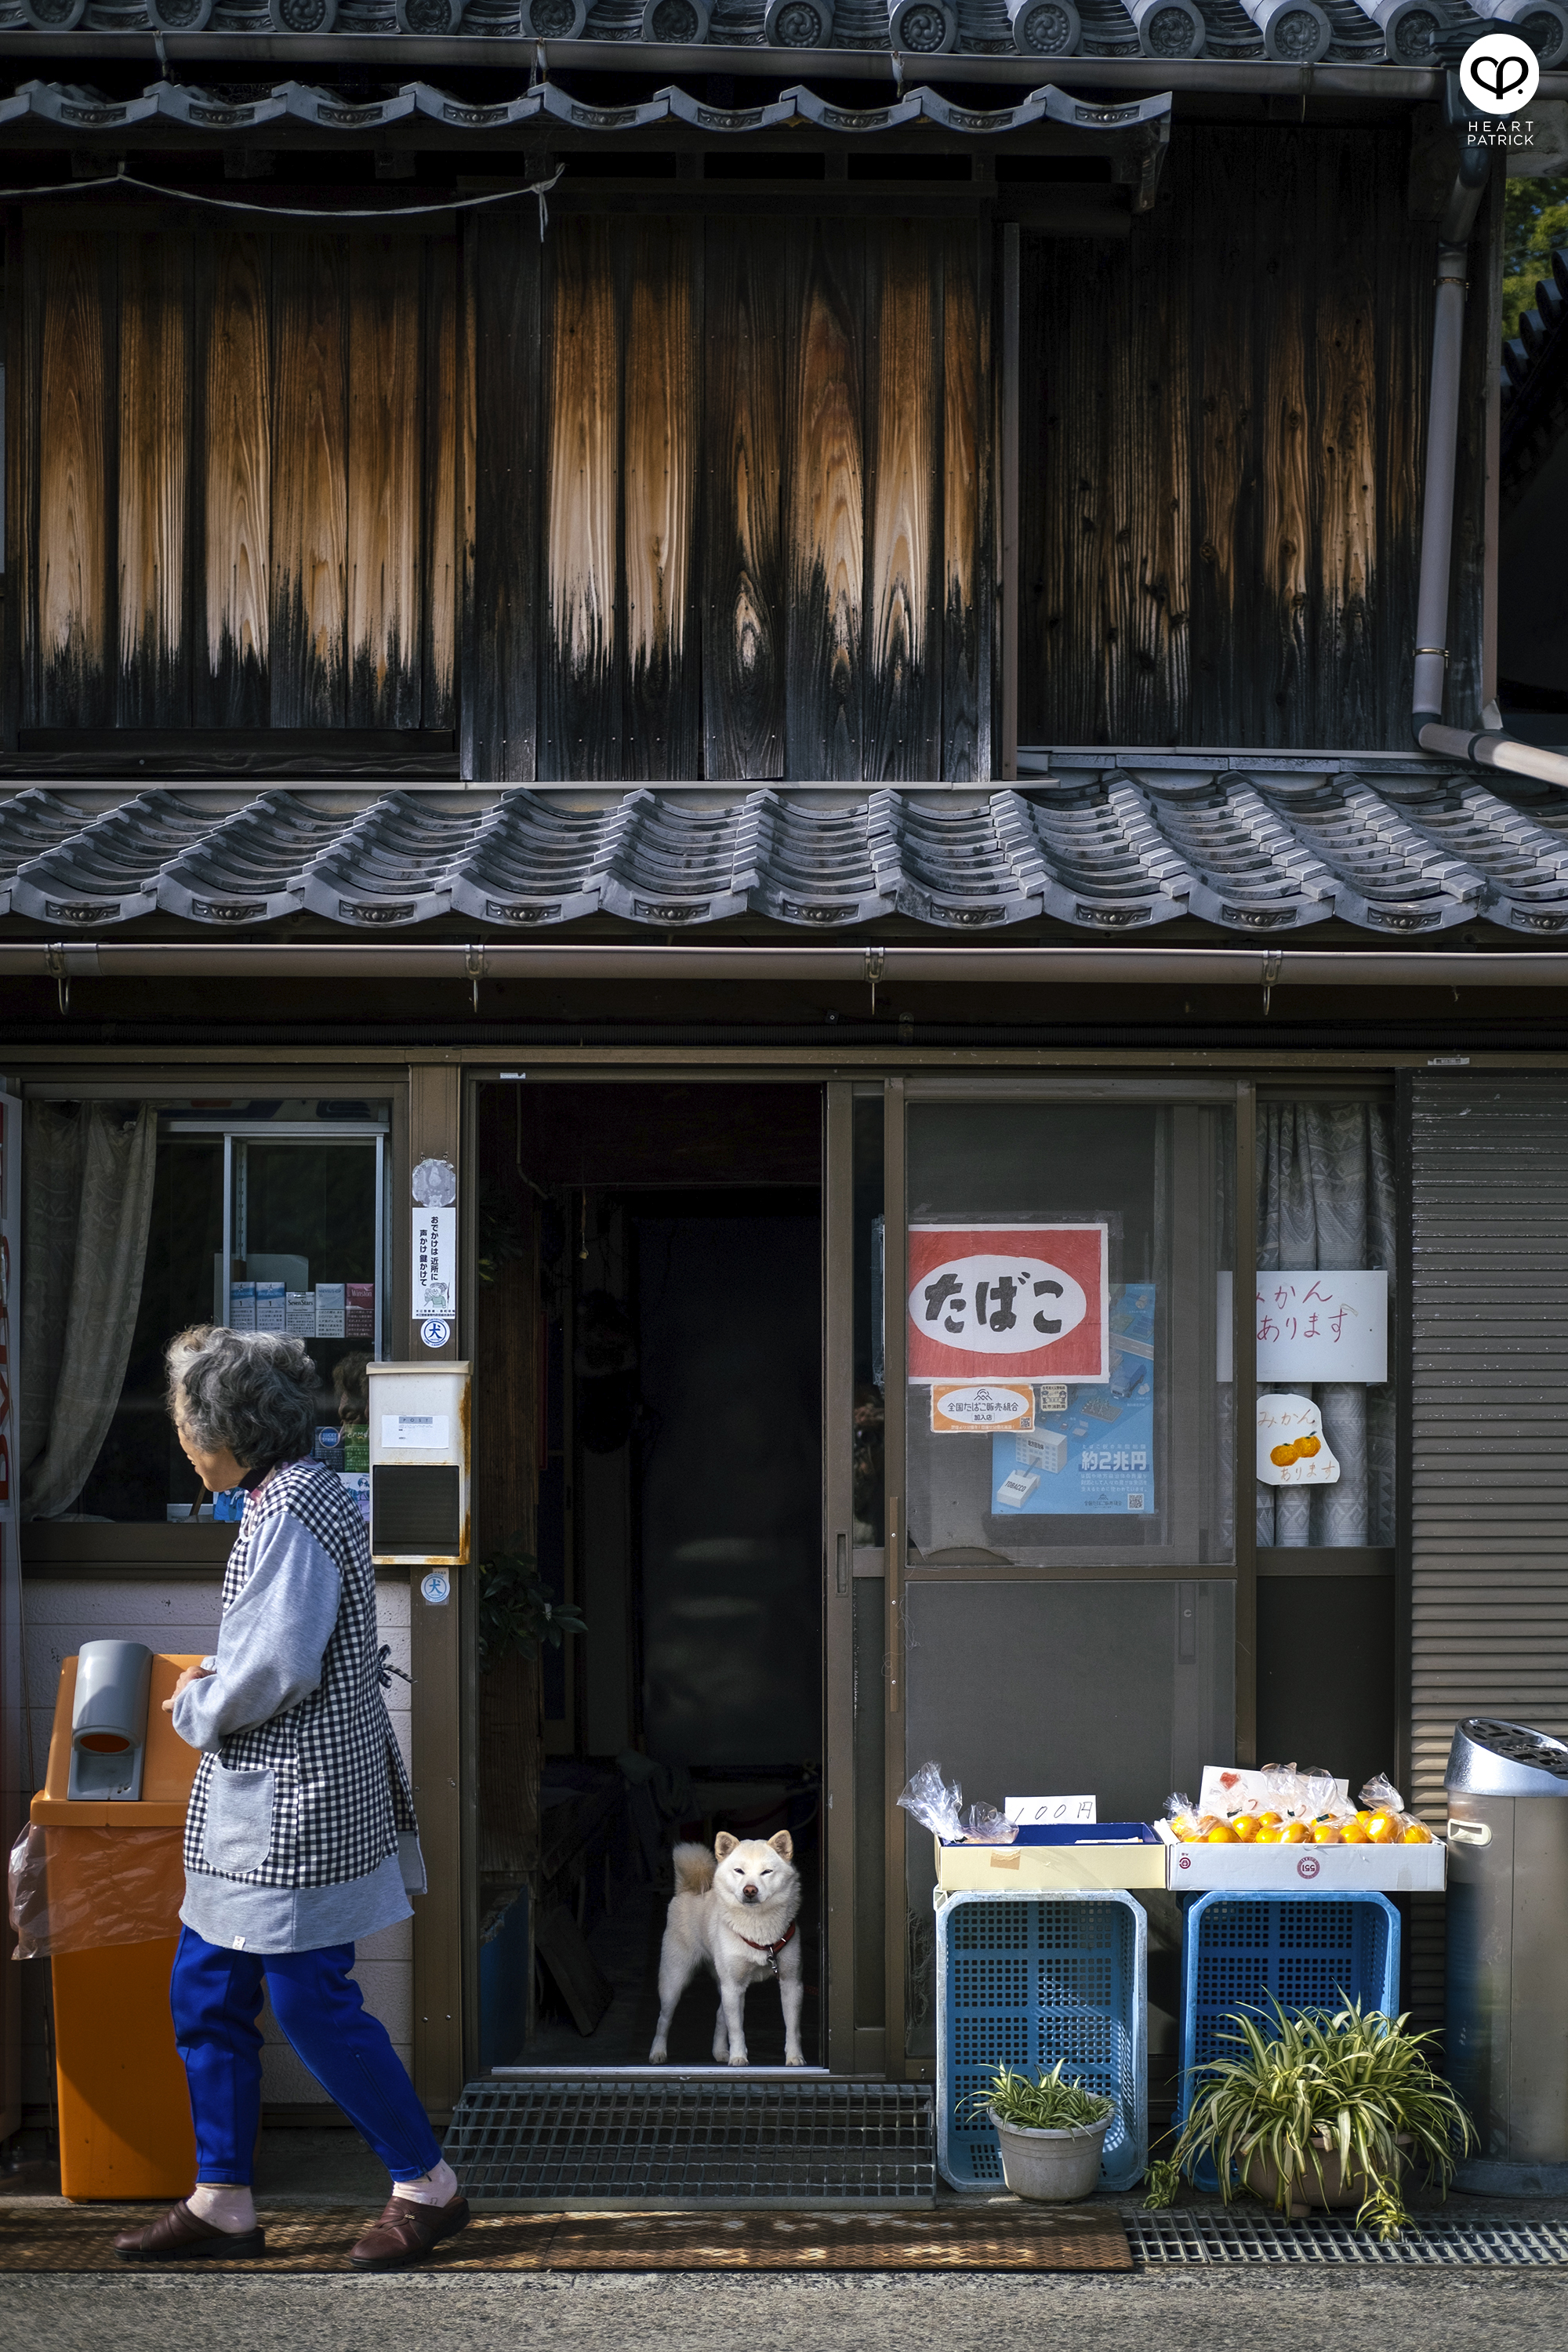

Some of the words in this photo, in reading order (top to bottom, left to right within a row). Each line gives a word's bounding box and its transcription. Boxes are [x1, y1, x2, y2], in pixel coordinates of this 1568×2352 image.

[419, 1229, 428, 1253] 声かけ
[430, 1216, 439, 1255] おでかけは
[419, 1254, 428, 1287] 鍵かけて
[430, 1257, 439, 1281] 近所に
[924, 1272, 1064, 1334] たばこ
[428, 1323, 442, 1338] 犬
[1257, 1308, 1348, 1343] あります
[947, 1402, 1019, 1412] 全国たばこ販売組合
[1258, 1409, 1316, 1428] みかん
[1082, 1450, 1146, 1472] 約2兆円
[1280, 1460, 1335, 1482] あります
[1004, 1481, 1027, 1492] TOBACCO
[428, 1578, 443, 1594] 犬
[1014, 1801, 1093, 1822] 100円
